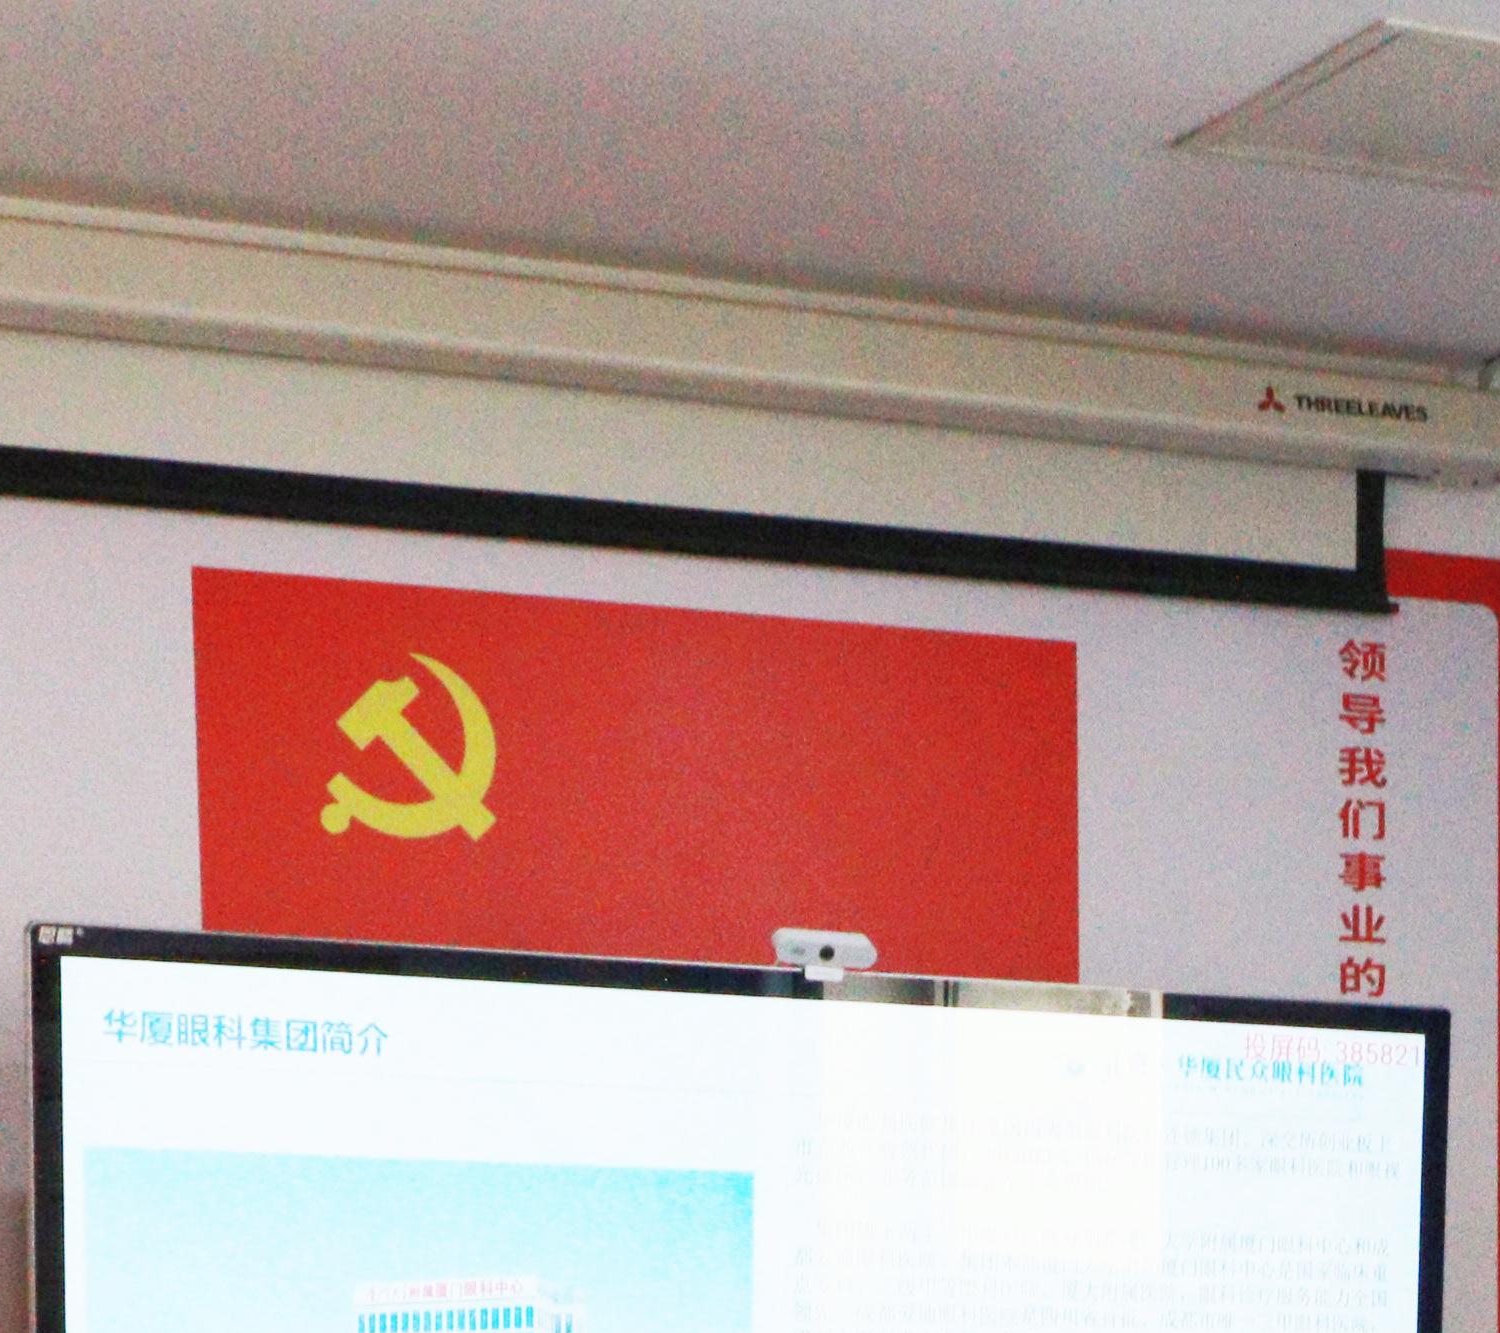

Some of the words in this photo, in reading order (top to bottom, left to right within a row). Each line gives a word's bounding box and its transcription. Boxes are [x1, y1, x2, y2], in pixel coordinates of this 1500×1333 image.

[1294, 392, 1428, 423] THREELEAVES
[1337, 639, 1387, 998] 领导我们事业的
[102, 1008, 389, 1057] 华厦眼科集团简介
